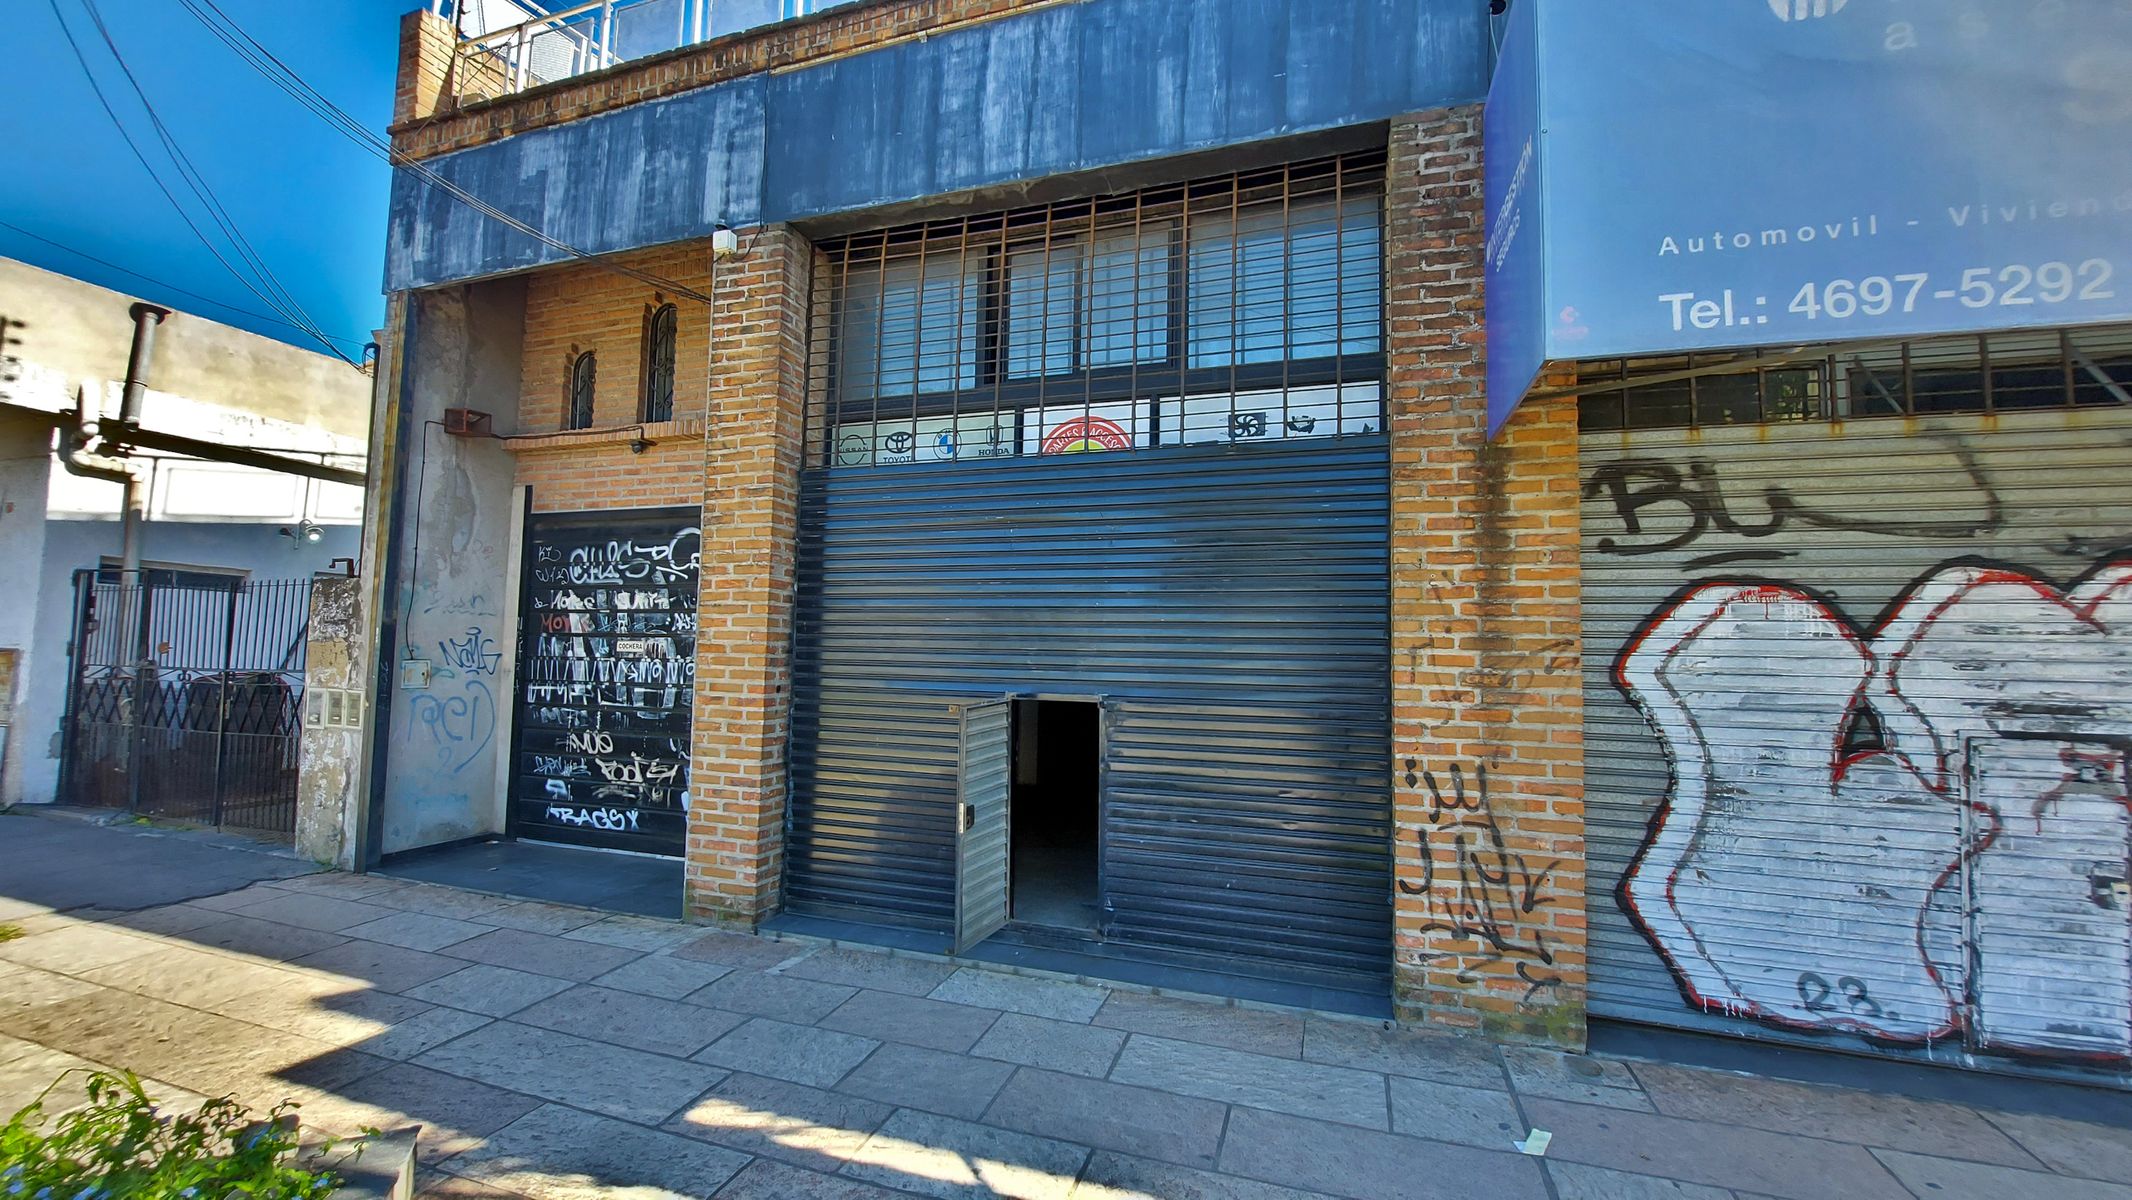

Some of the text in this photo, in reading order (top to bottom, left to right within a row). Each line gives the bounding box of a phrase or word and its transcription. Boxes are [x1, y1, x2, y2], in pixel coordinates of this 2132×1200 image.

[1658, 214, 1877, 256] Automovil
[1658, 258, 2115, 331] Tel.: 4697-5292
[883, 455, 917, 464] TOYOT
[618, 642, 643, 650] COCHERA
